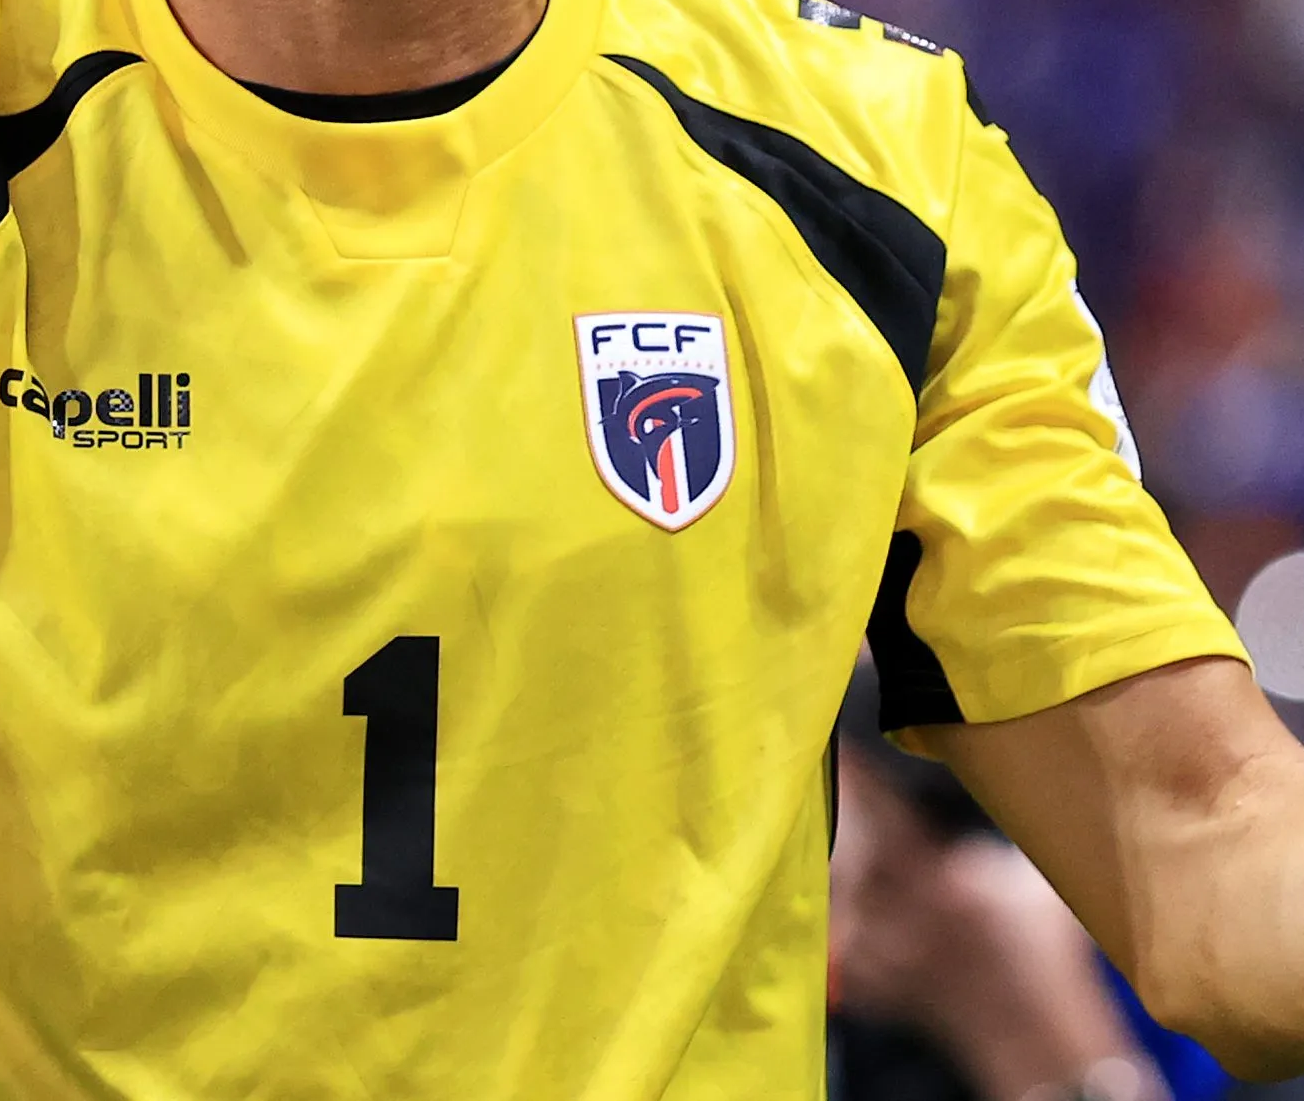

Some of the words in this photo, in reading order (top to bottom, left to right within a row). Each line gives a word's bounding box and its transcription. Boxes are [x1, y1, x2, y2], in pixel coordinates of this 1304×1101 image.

[591, 322, 712, 355] FCF
[72, 430, 192, 449] SPORT
[334, 635, 459, 942] 1
